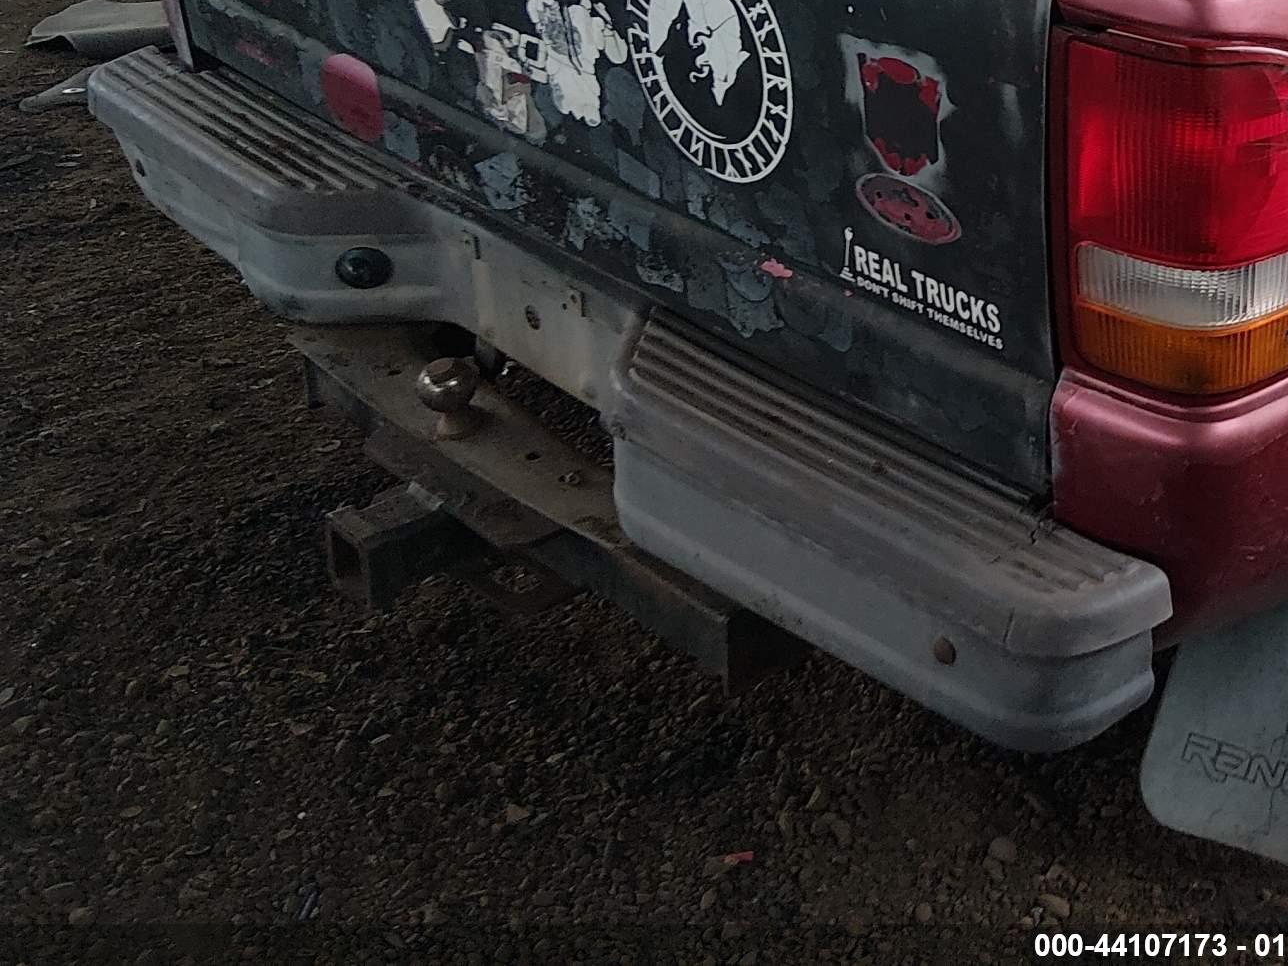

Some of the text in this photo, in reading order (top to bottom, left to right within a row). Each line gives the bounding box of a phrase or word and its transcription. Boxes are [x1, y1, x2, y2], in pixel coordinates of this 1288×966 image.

[854, 245, 1001, 333] REAL TRUCKS
[891, 292, 925, 314] SHIFT
[926, 308, 1004, 350] THEMSELVES
